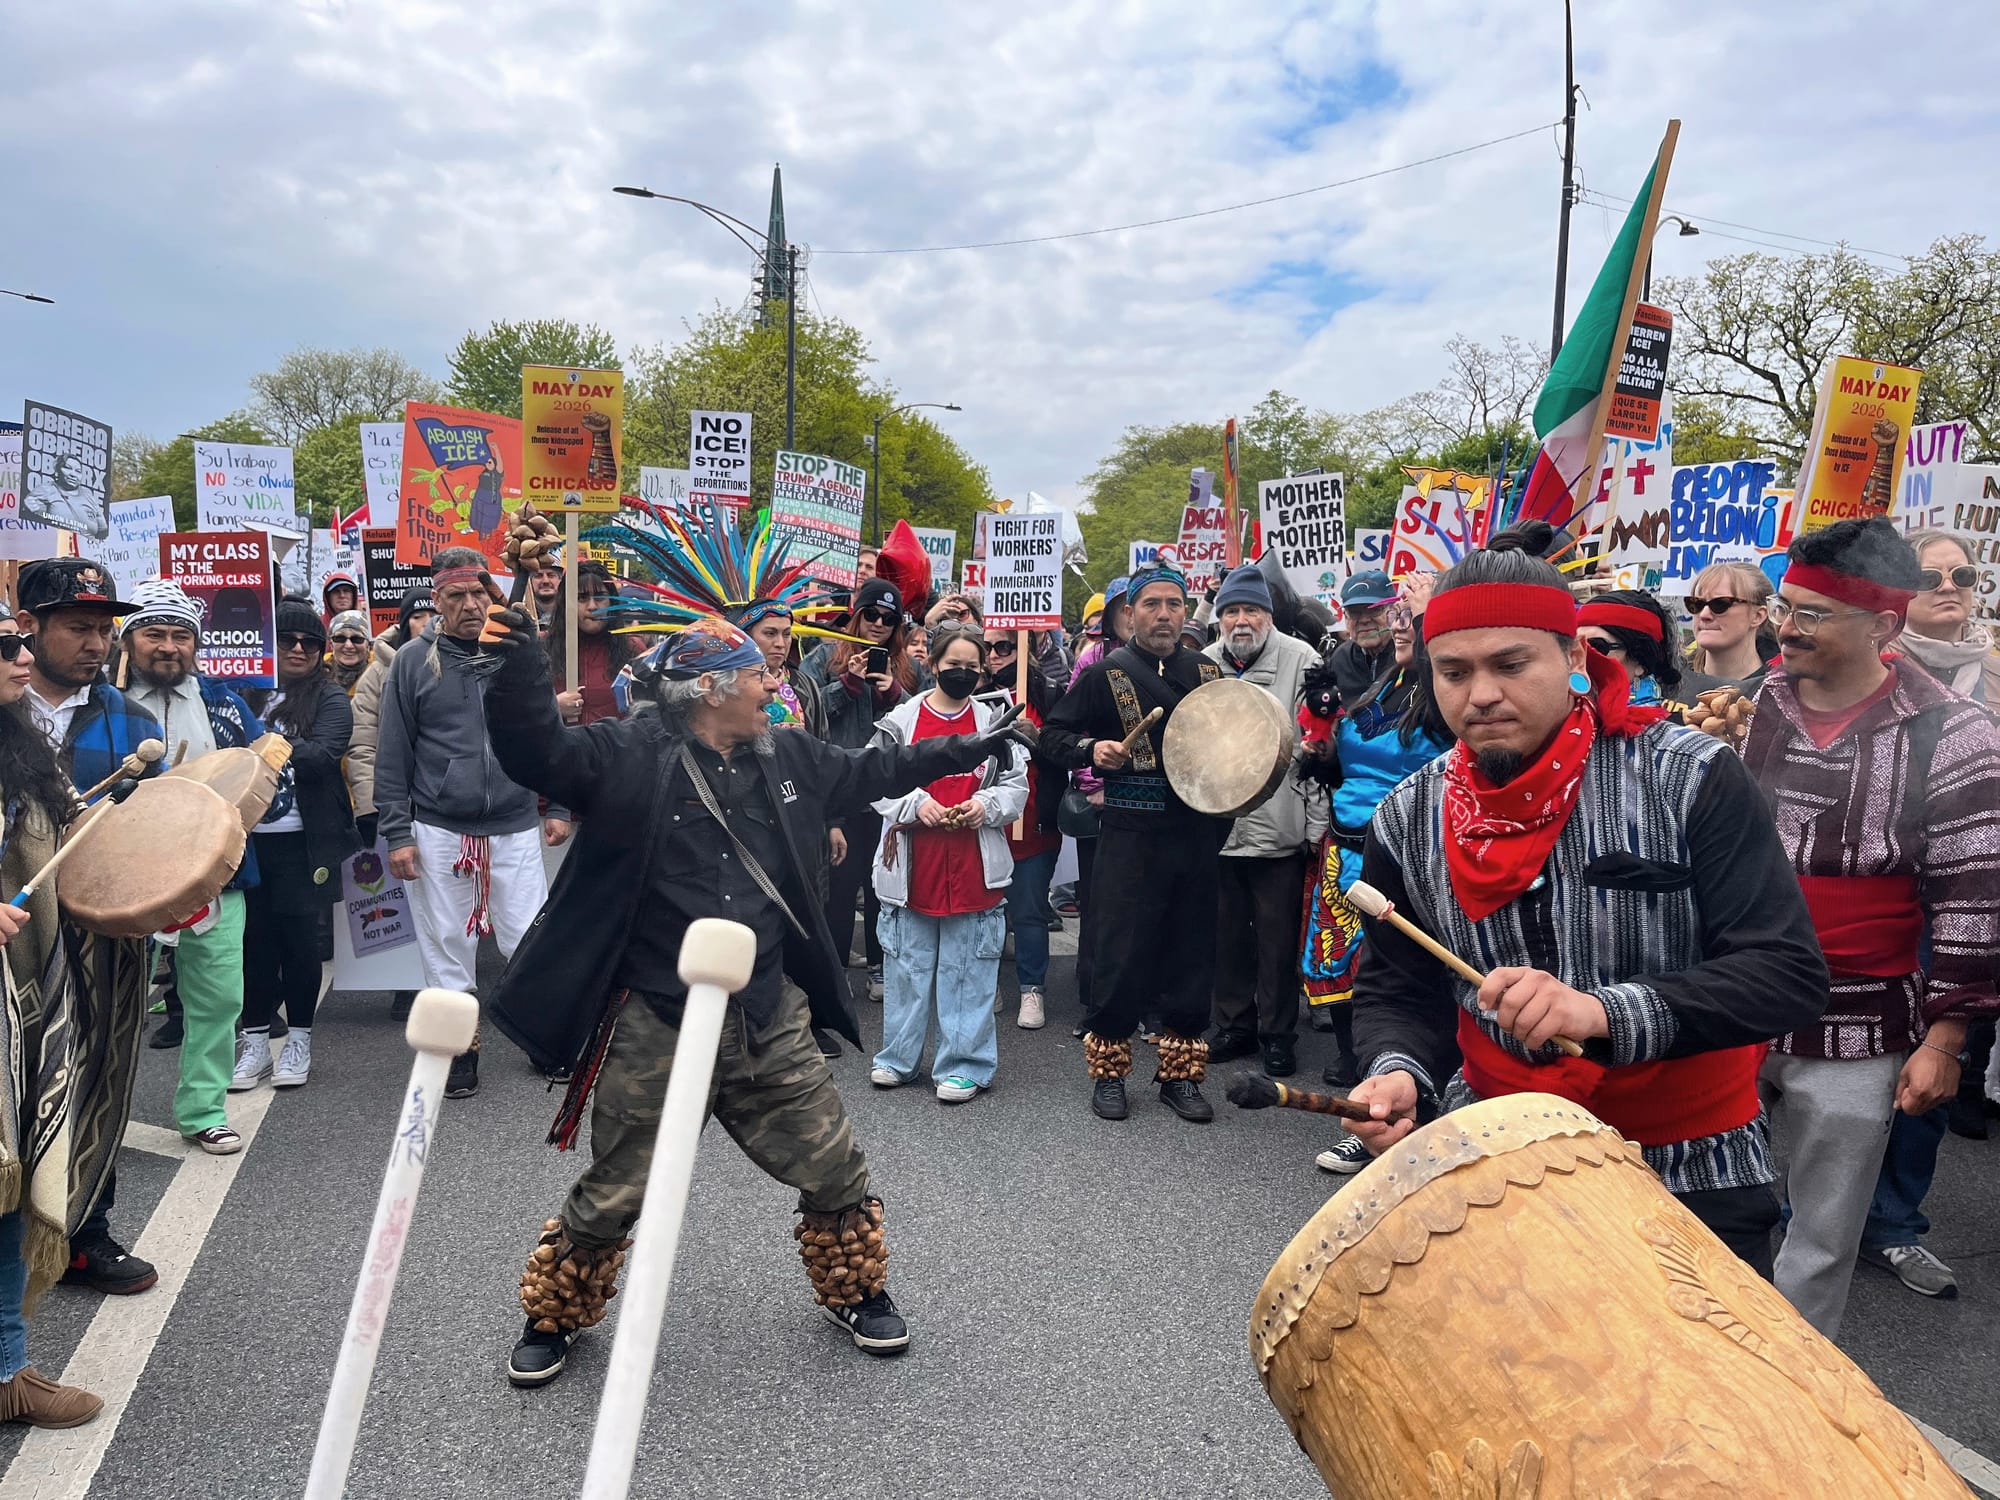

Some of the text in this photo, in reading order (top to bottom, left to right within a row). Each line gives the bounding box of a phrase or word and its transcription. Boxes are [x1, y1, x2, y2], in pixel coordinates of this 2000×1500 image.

[532, 381, 615, 398] MAY DAY
[1839, 376, 1912, 403] MAY DAY
[553, 399, 592, 412] 2026
[1612, 407, 1647, 422] LARGUE
[1851, 402, 1886, 419] 2026
[29, 407, 108, 450] OBRERA
[700, 416, 742, 434] NO
[426, 427, 483, 445] ABOLISH
[695, 435, 747, 454] ICE!
[441, 444, 478, 462] ICE
[695, 456, 745, 469] STOP
[26, 450, 106, 493] OBRX
[205, 471, 226, 487] NO
[708, 470, 732, 478] THE
[778, 453, 863, 488] STOP THE
[529, 476, 616, 491] CHICAGO
[694, 477, 748, 491] DEPORTATIONS
[776, 470, 862, 499] TRUMP AGENDA!
[1904, 470, 1933, 508] IN
[242, 491, 285, 512] VIDA
[774, 489, 863, 515] IMMIGRANT RIGHTS
[775, 482, 813, 494] DEFEND
[829, 492, 864, 508] EXPAND
[1265, 478, 1343, 511] MOTHER
[407, 497, 445, 528] Free
[1183, 507, 1249, 531] DIGNY
[1278, 502, 1341, 527] EARTH
[1401, 496, 1442, 536] SI
[1890, 505, 1945, 534] HE
[406, 518, 451, 544] Them
[832, 524, 860, 539] CRIMES
[994, 519, 1055, 537] FIGHT FOR
[1266, 519, 1344, 549] MOTHER
[805, 528, 842, 542] LGBTQIA+
[844, 537, 860, 549] AND
[992, 538, 1057, 557] WORKERS'
[170, 542, 260, 561] MY CLASS
[336, 551, 352, 560] FIGH
[833, 543, 859, 556] RIGHTS
[1282, 545, 1343, 569] EARTH
[171, 561, 214, 574] IS THE
[1013, 559, 1034, 573] AND
[172, 573, 262, 586] WORKING CLASS
[373, 576, 434, 589] NO MILITARY
[990, 575, 1057, 589] IMMIGRANTS'
[1185, 573, 1212, 592] ORK
[994, 591, 1052, 613] RIGHTS
[202, 630, 264, 645] SCHOOL
[209, 647, 264, 658] WORKER'S
[348, 887, 404, 915] COMMUNITIES
[363, 921, 402, 941] NOT WAR
